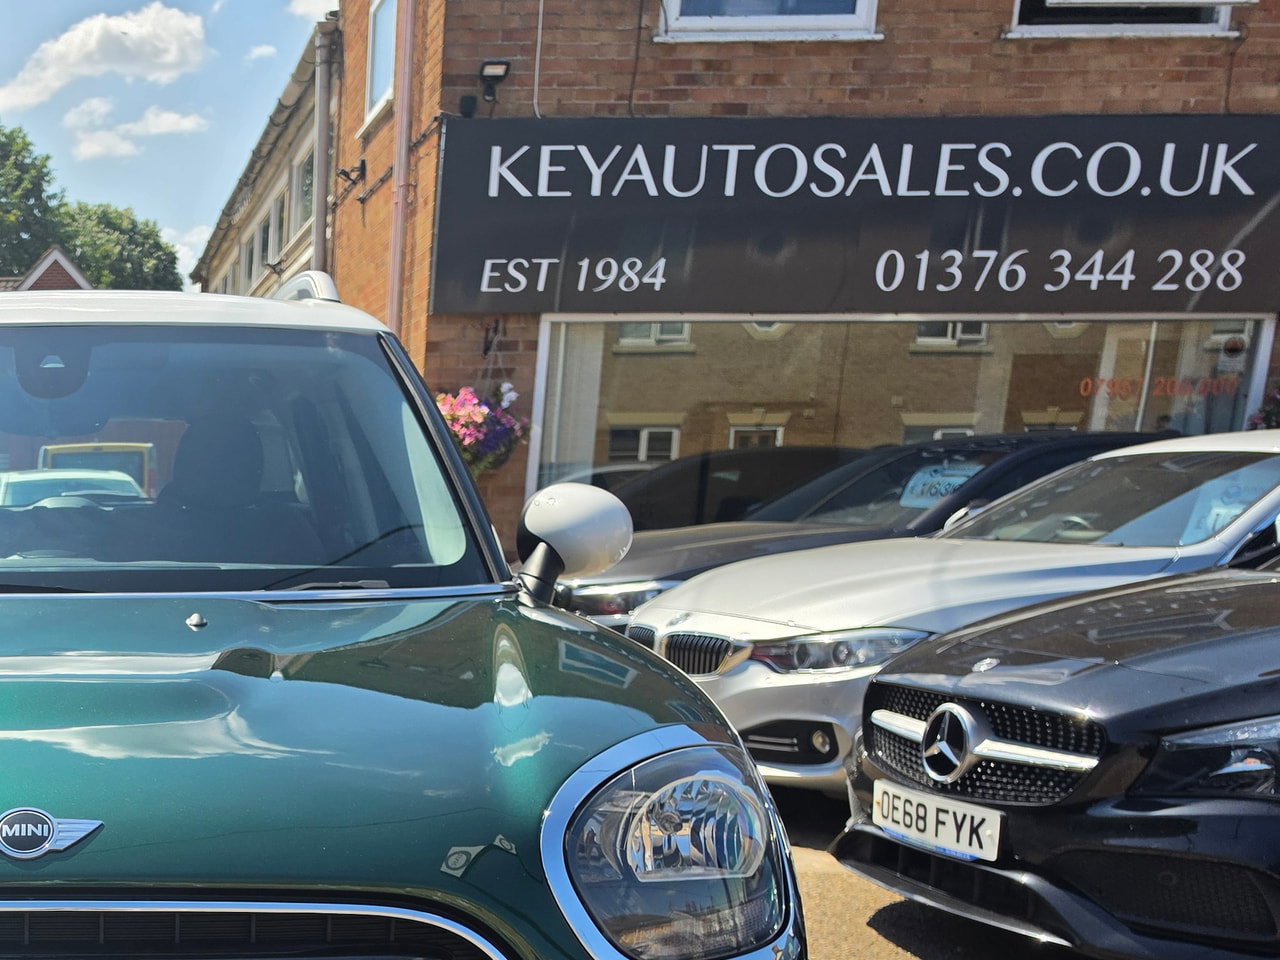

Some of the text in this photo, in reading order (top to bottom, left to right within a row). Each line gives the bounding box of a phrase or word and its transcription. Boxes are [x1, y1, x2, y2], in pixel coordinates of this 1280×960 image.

[488, 142, 1258, 198] KEYAUTOSALES.CO.UK
[480, 257, 667, 293] EST 1984
[875, 249, 1246, 292] 01376 344 288
[1, 823, 49, 838] MINI
[881, 790, 986, 850] OE68 FYK
